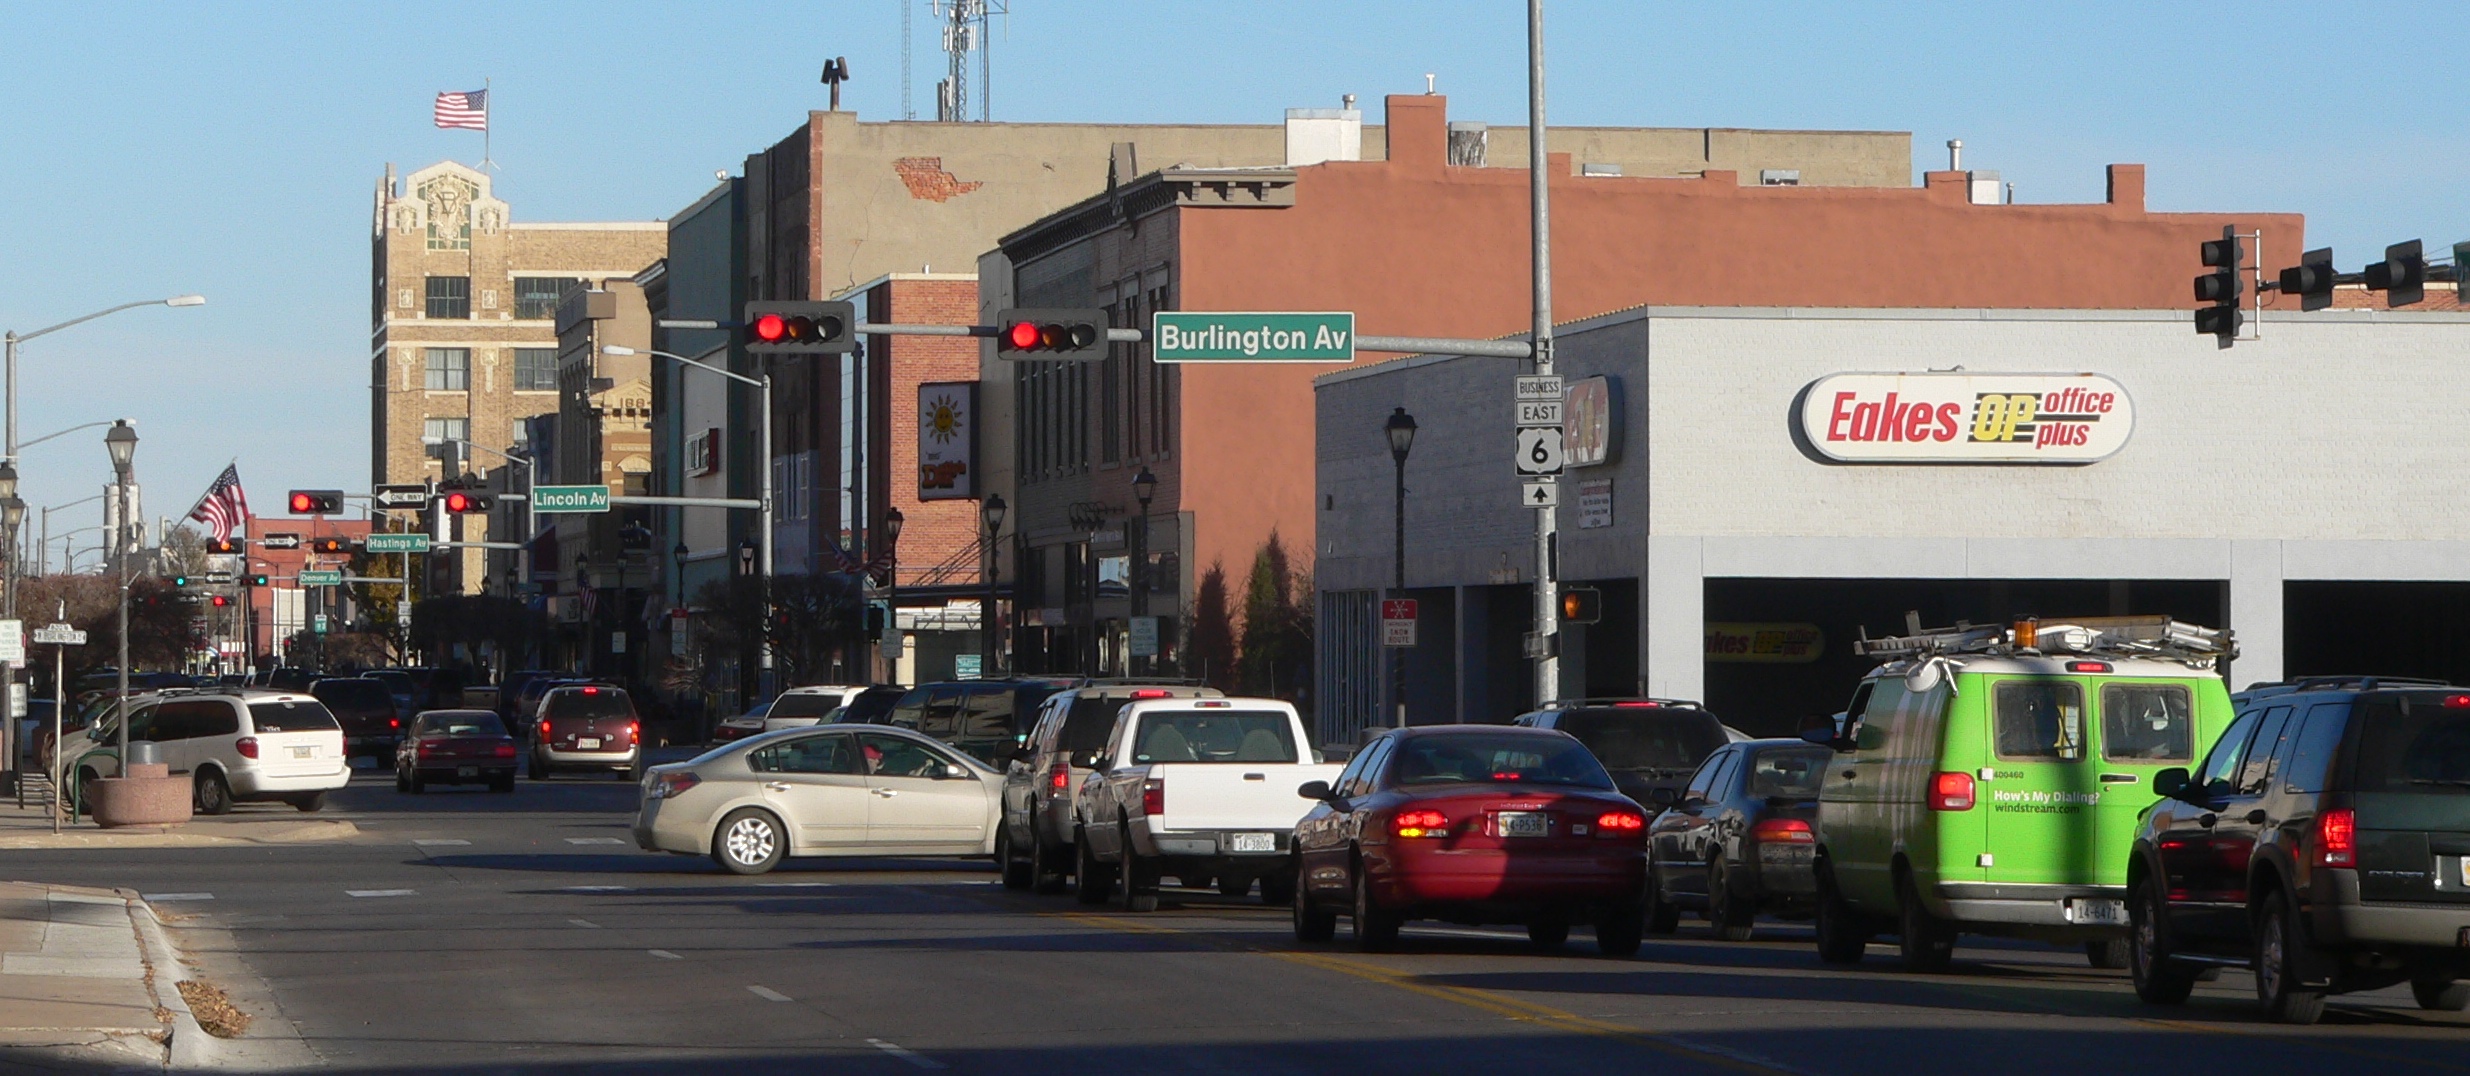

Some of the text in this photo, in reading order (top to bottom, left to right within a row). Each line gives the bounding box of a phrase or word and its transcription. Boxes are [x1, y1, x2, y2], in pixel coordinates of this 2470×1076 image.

[1161, 324, 1347, 355] Burlington Av
[1519, 381, 1560, 394] BUSINESS
[1523, 405, 1557, 420] EAST
[1826, 387, 2115, 442] Eakes OP office
[2036, 420, 2090, 449] plus
[1531, 437, 1549, 464] 6
[390, 492, 422, 502] ONE WAY
[534, 491, 606, 506] Lincoln Av
[369, 535, 427, 549] Hastings Av
[300, 573, 327, 582] Denver
[1993, 789, 2101, 805] How's My Dialing?
[1994, 803, 2081, 814] windstream.com
